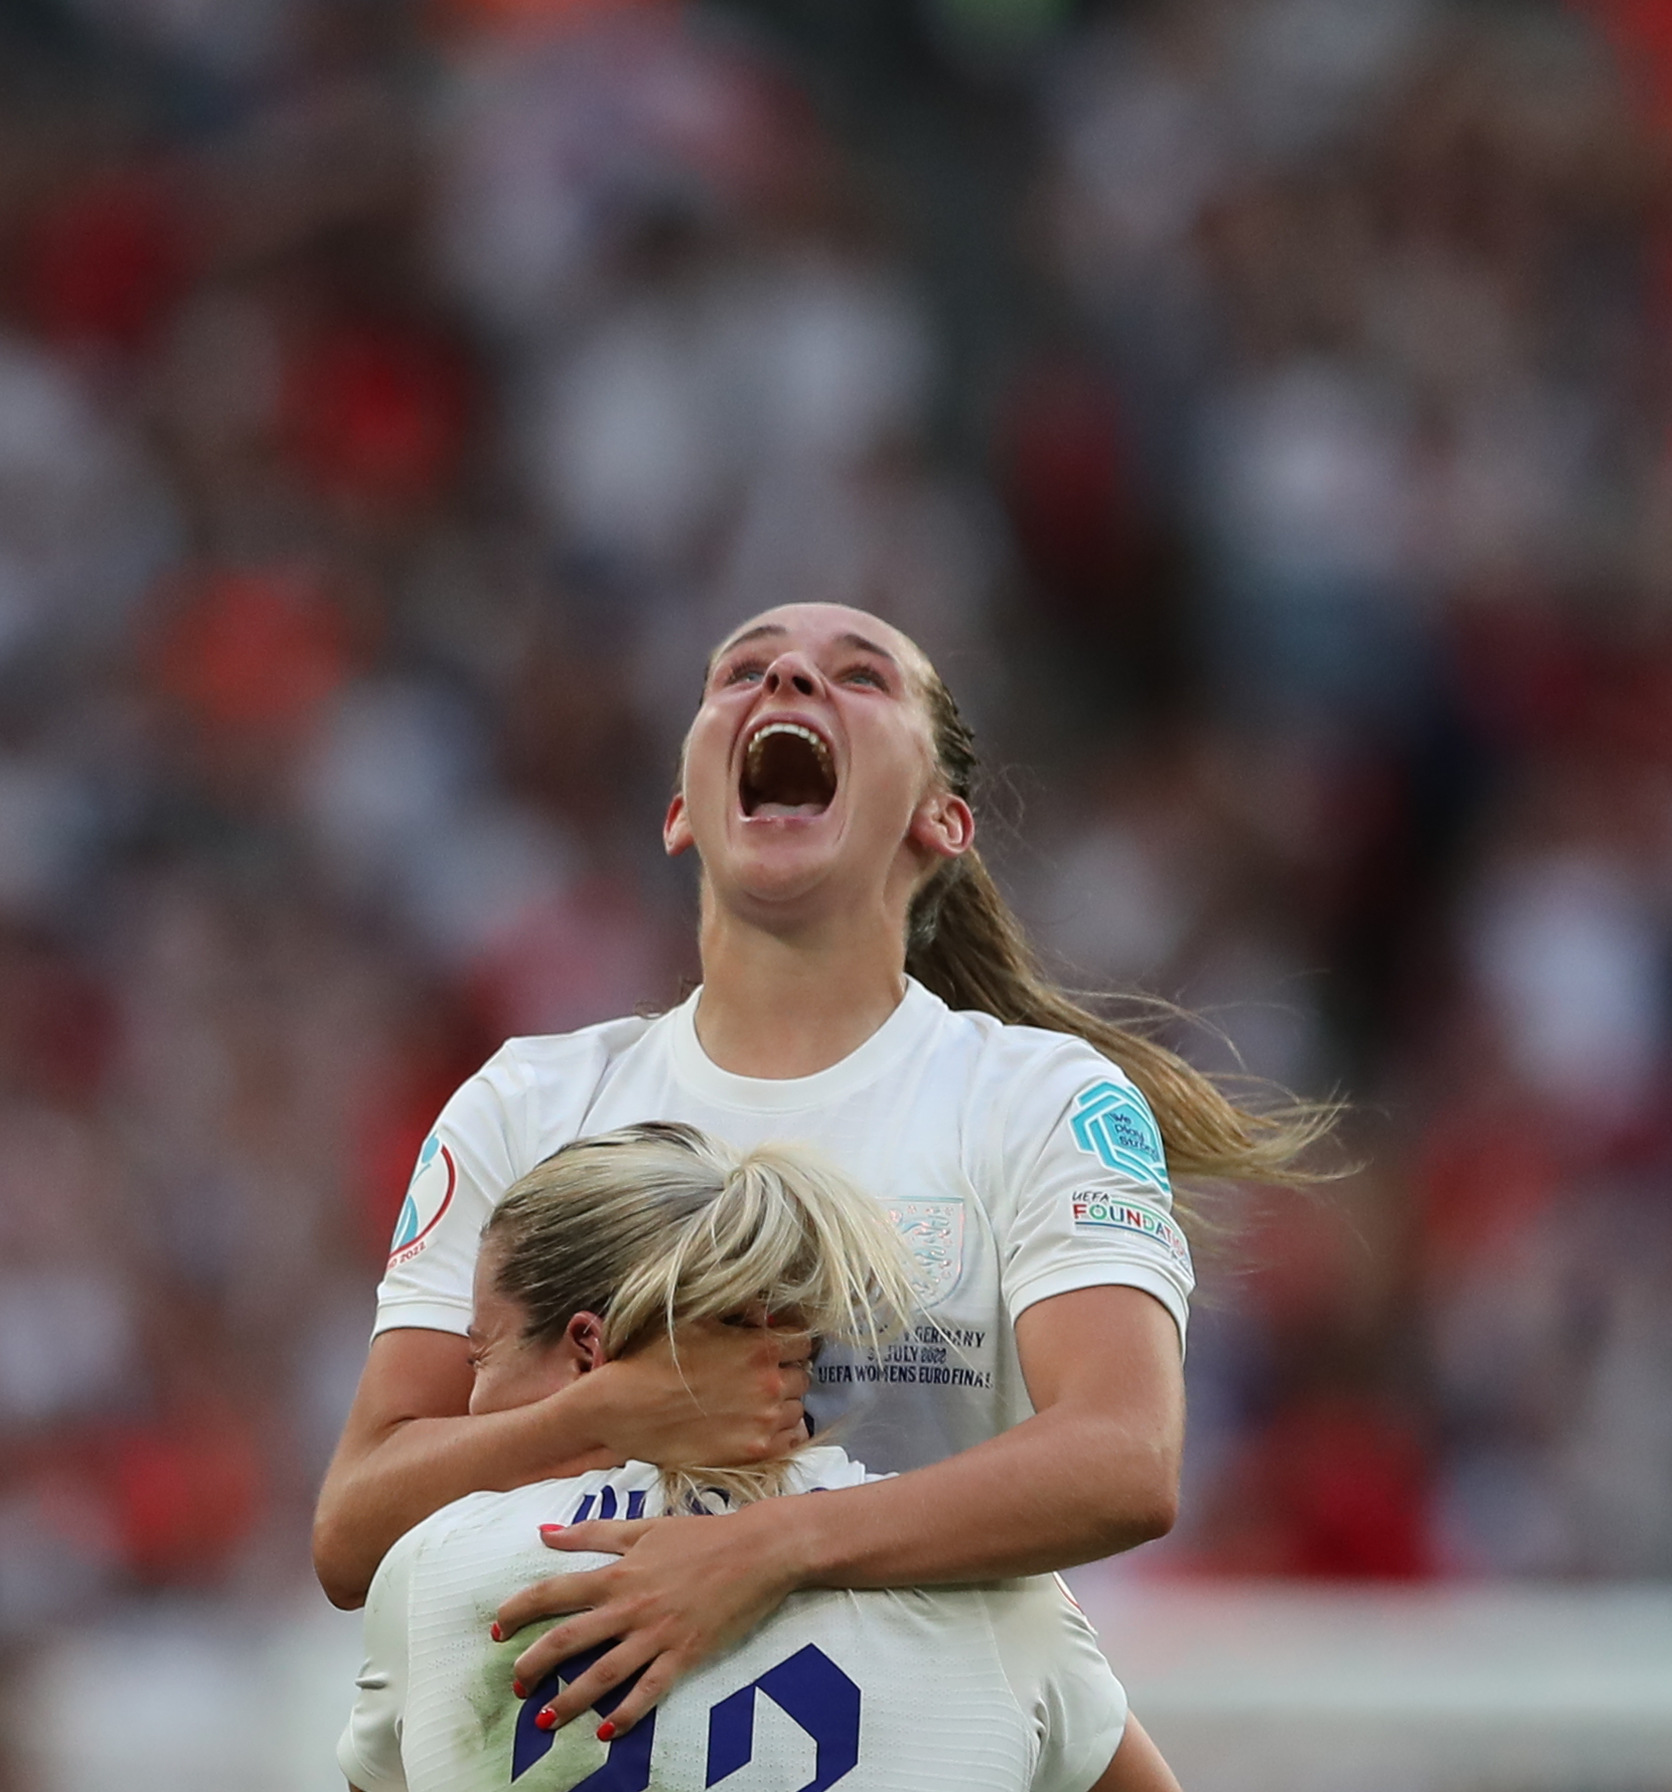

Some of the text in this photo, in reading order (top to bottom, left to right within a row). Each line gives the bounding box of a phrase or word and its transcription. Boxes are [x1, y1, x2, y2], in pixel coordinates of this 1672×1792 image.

[1114, 1124, 1145, 1143] play
[1072, 1190, 1110, 1203] UEFA
[399, 1241, 426, 1264] 2022
[914, 1325, 986, 1348] GERMANY
[884, 1344, 918, 1363] JULY
[818, 1365, 994, 1389] UEFA WOMENS EURO FINAL
